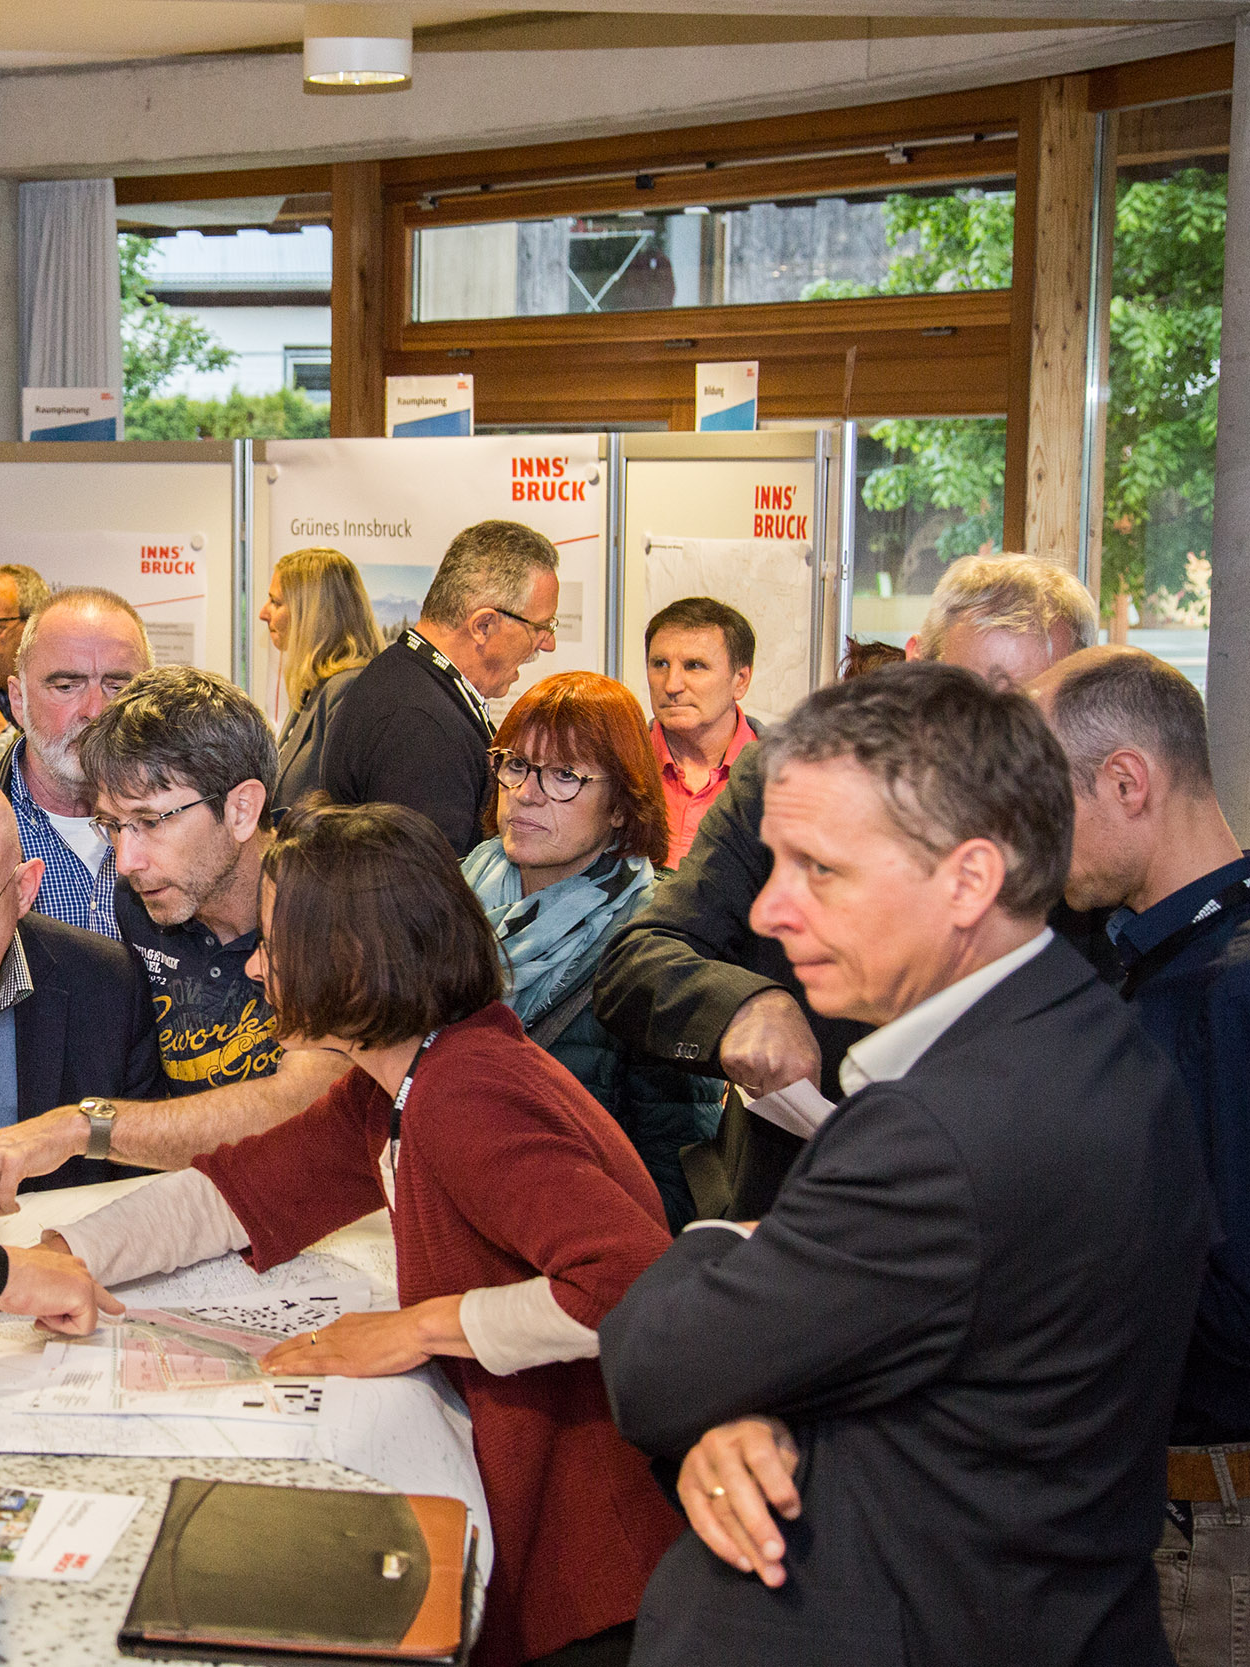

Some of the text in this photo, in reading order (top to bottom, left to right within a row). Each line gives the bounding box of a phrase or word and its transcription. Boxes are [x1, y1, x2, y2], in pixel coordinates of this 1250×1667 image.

[35, 404, 90, 416] Raumplanung
[397, 395, 448, 408] Raumplanung
[511, 456, 569, 478] INNS'
[512, 480, 586, 501] BRUCK
[754, 485, 797, 510] INNS'
[291, 517, 412, 538] Grünes Innsbruck
[753, 514, 808, 540] BRUCK
[141, 545, 184, 560] INNS'
[141, 561, 195, 575] BRUCK
[394, 1076, 413, 1111] BRUCK
